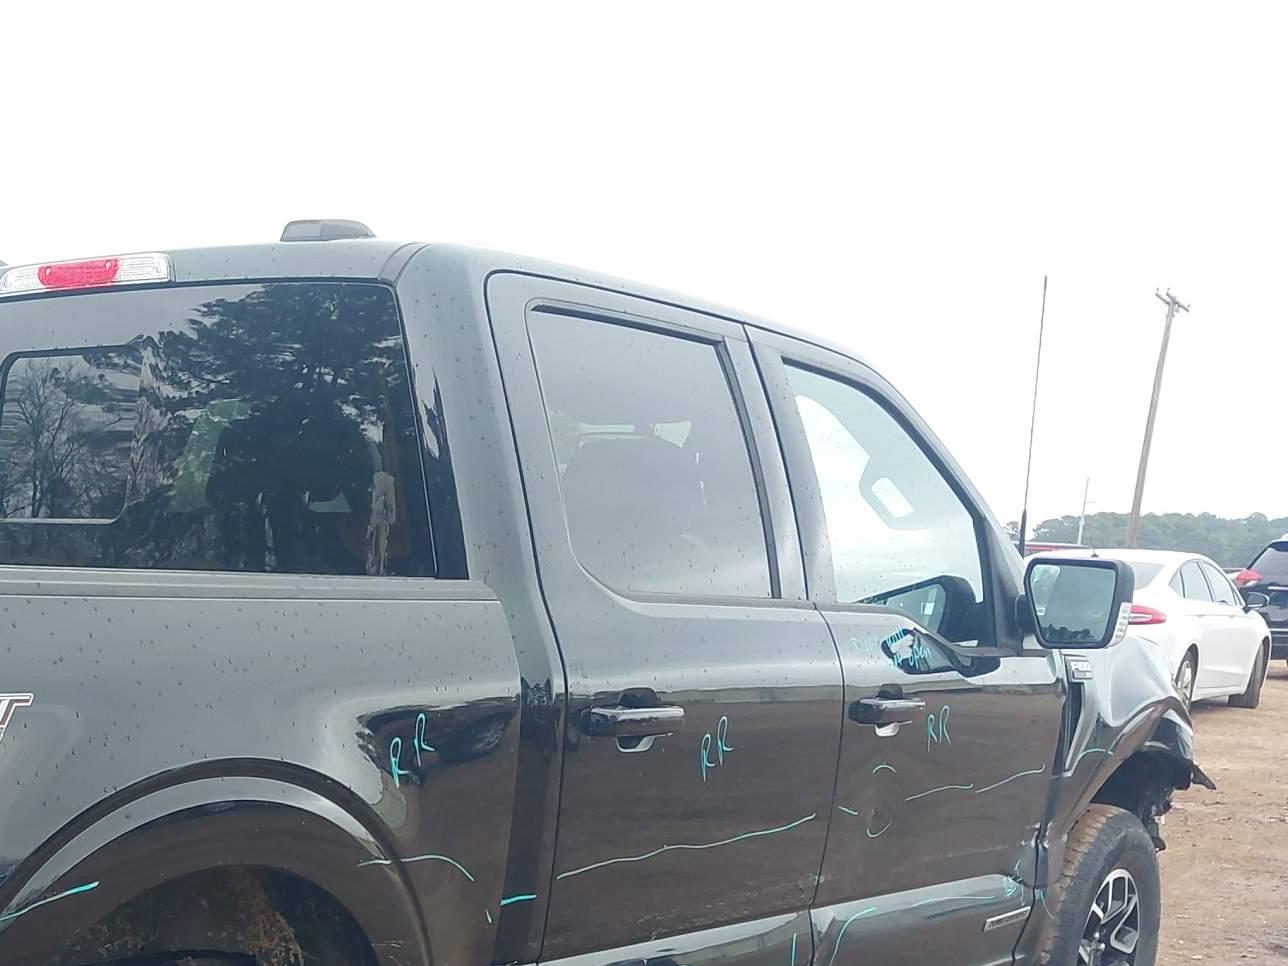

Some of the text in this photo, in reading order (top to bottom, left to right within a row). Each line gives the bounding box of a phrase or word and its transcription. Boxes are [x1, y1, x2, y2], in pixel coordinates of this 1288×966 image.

[390, 712, 436, 788] RR
[701, 715, 734, 782] RR
[928, 704, 952, 752] RR
